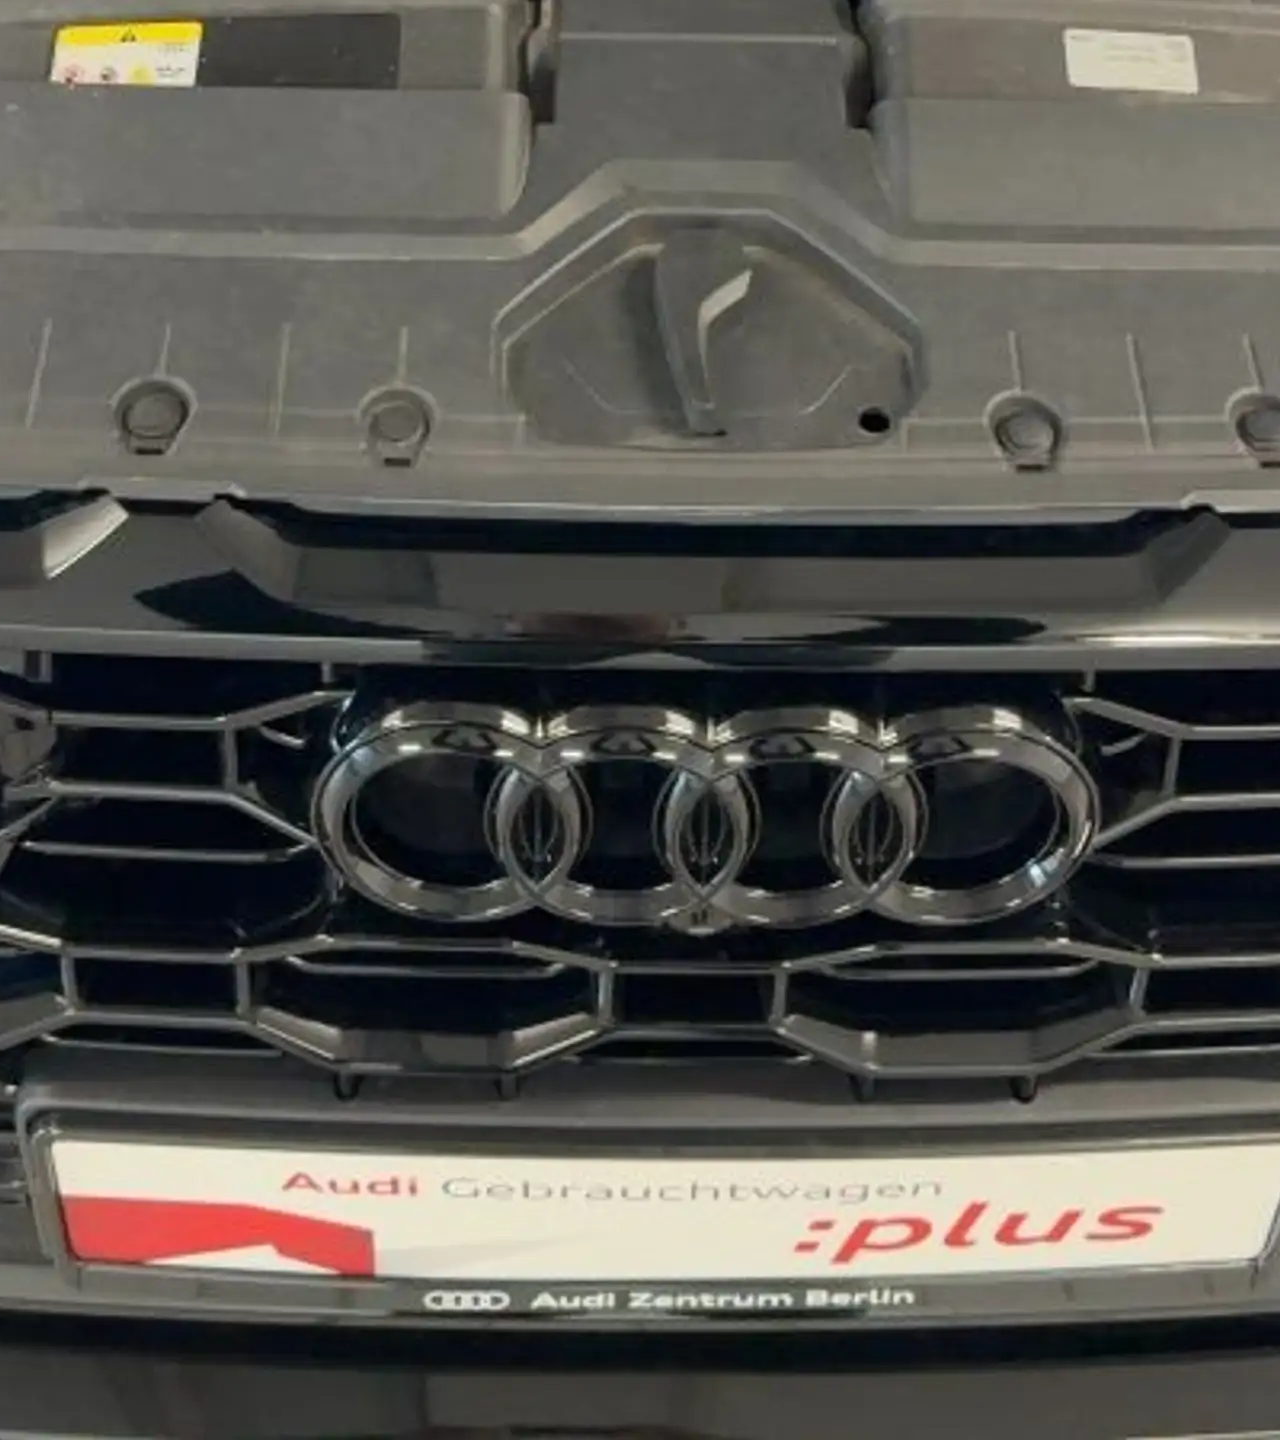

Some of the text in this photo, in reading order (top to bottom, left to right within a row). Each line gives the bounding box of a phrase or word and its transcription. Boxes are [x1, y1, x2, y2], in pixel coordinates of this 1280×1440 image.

[281, 1172, 943, 1204] Audi Gebrauchtwagen
[794, 1201, 1164, 1264] :plus
[530, 1288, 916, 1310] Audi Zentrum Berlin
